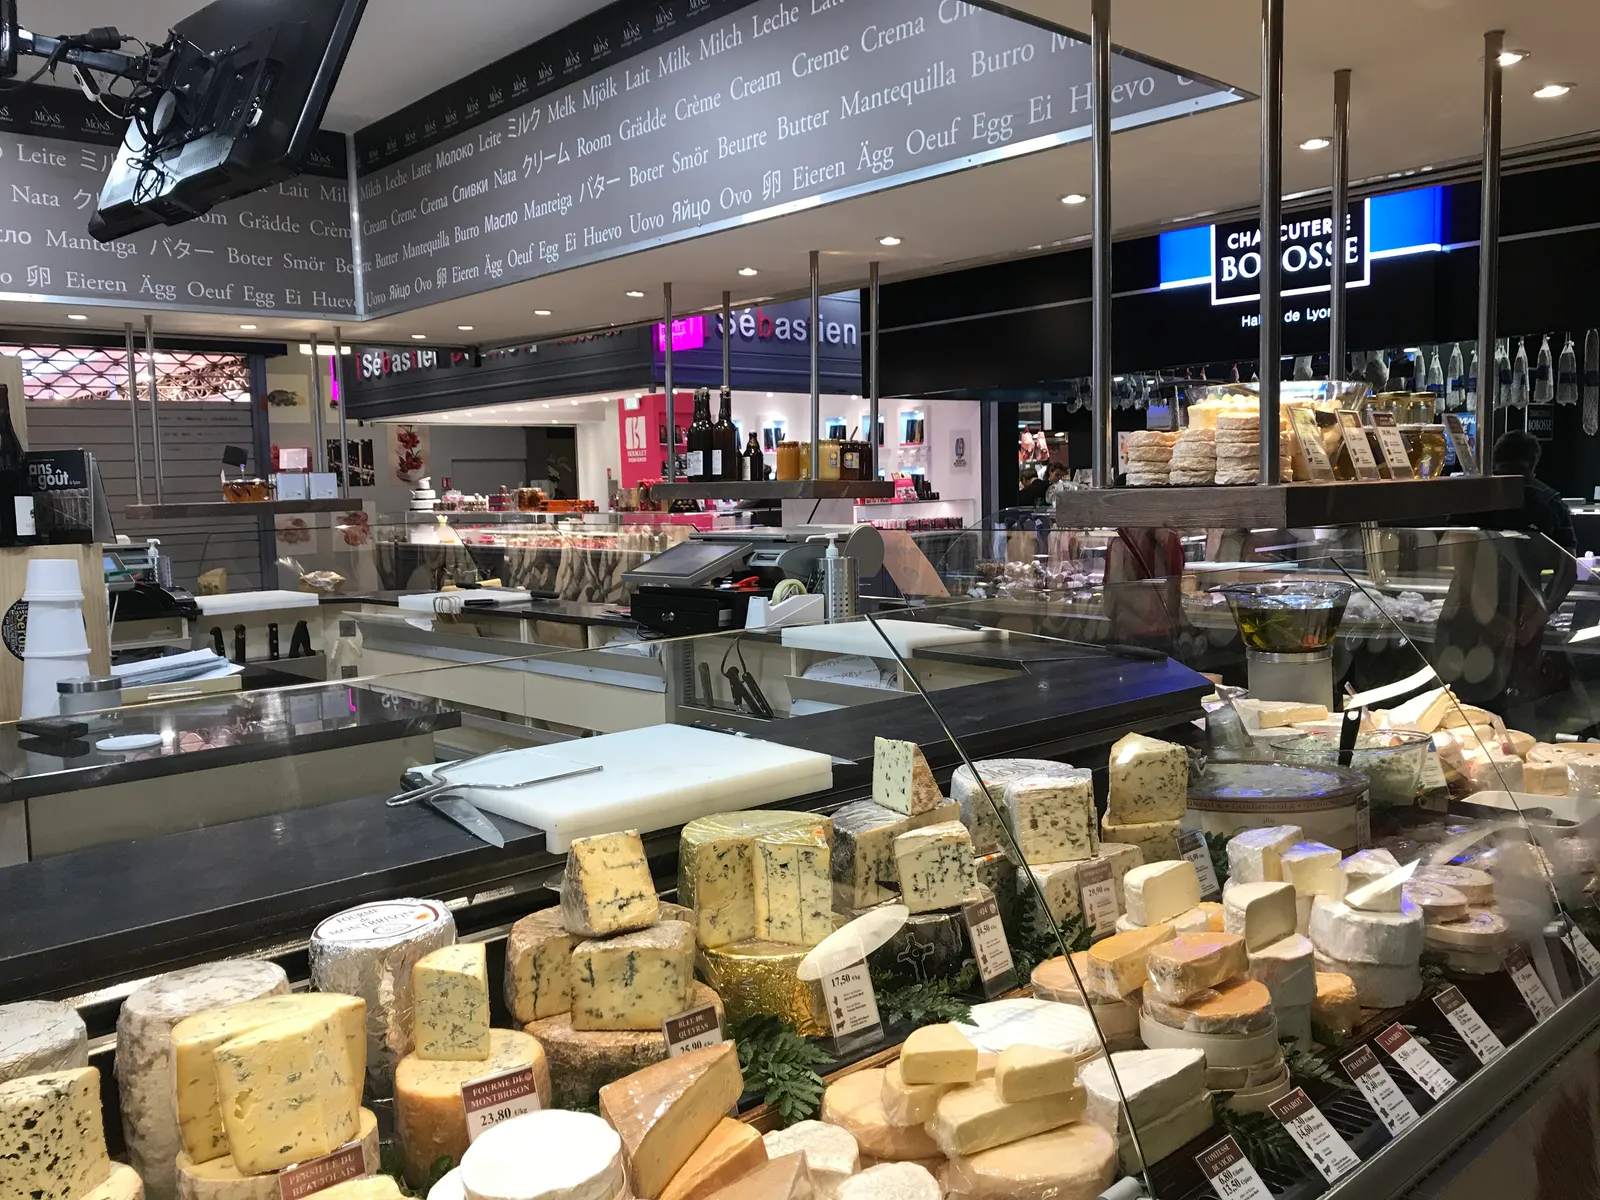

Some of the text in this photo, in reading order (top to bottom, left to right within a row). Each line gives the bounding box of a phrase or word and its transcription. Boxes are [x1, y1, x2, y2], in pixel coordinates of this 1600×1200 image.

[360, 0, 846, 201] Milch Leche Latte Молоко Leite ミルク Melk Mjölk Lait Milk Milch Leche Lat
[363, 16, 925, 237] Cream Creme Crema Сливки Nata クリーム Room Grädde Crème Cream Creme Crema
[16, 143, 67, 167] Leite
[376, 251, 399, 269] Butter
[402, 230, 450, 261] Mantequilla
[454, 225, 480, 244] Burro
[484, 210, 518, 234] Масло
[524, 193, 573, 221] Manteiga
[579, 174, 621, 204] バター
[629, 163, 665, 188] Boter
[671, 146, 709, 175] Smör
[717, 130, 767, 160] Beurre
[776, 110, 830, 141] Butter
[840, 60, 957, 120] Mantequilla
[970, 43, 1036, 79] Burro
[11, 184, 61, 208] Nata
[280, 182, 348, 203] Lait Mil
[366, 291, 387, 308] Uovo
[389, 282, 411, 301] Яйцо
[414, 276, 433, 294] Ovo
[436, 267, 448, 290] 卵
[451, 266, 479, 284] Eieren
[483, 253, 503, 279] Ägg
[507, 242, 535, 268] Oeuf
[538, 240, 560, 264] Egg
[564, 232, 578, 253] Ei
[583, 225, 623, 248] Huevo
[629, 212, 665, 234] Uovo
[672, 199, 711, 224] Яйцо
[719, 187, 753, 210] Ovo
[762, 170, 781, 201] 卵
[792, 160, 846, 191] Eieren
[856, 140, 895, 174] Ägg
[906, 116, 962, 155] Oeuf
[970, 111, 1014, 145] Egg
[1028, 94, 1053, 126] Ei
[1070, 76, 1156, 114] Hevo
[239, 211, 301, 233] Grädde
[309, 219, 352, 239] Crèm
[1227, 213, 1351, 250] CHACUTER
[46, 229, 138, 260] Manteiga
[150, 237, 215, 259] バター
[227, 247, 273, 268] Boter
[283, 252, 326, 272] Smör
[1221, 236, 1359, 282] BOOSSE
[26, 265, 52, 288] 卵
[65, 271, 128, 293] Eieren
[139, 274, 177, 301] Ägg
[187, 280, 235, 301] Oeuf
[244, 285, 276, 308] Egg
[285, 288, 302, 305] Ei
[312, 290, 355, 309] Huev
[716, 307, 857, 345] Sébasien
[1284, 310, 1301, 323] de
[29, 463, 53, 475] ans
[37, 468, 70, 491] goût
[1231, 802, 1298, 812] GORGONZOLA
[831, 974, 851, 988] 17,50
[679, 1040, 702, 1054] 2590
[1347, 1053, 1373, 1073] CHAOURCE
[470, 1083, 530, 1109] MONTBRISON
[472, 1074, 525, 1098] FOURME DE
[480, 1107, 512, 1127] 23,80
[1279, 1097, 1303, 1116] LIVAROT
[1290, 1116, 1306, 1130] 7,30
[1296, 1123, 1314, 1140] 14,60
[340, 1153, 356, 1166] DU
[1204, 1143, 1231, 1164] COMTESSE
[1211, 1153, 1235, 1173] DE VICHY
[292, 1165, 357, 1197] BEAUJOLAIS
[1217, 1169, 1234, 1186] 6,80
[1222, 1178, 1242, 1197] 13,50
